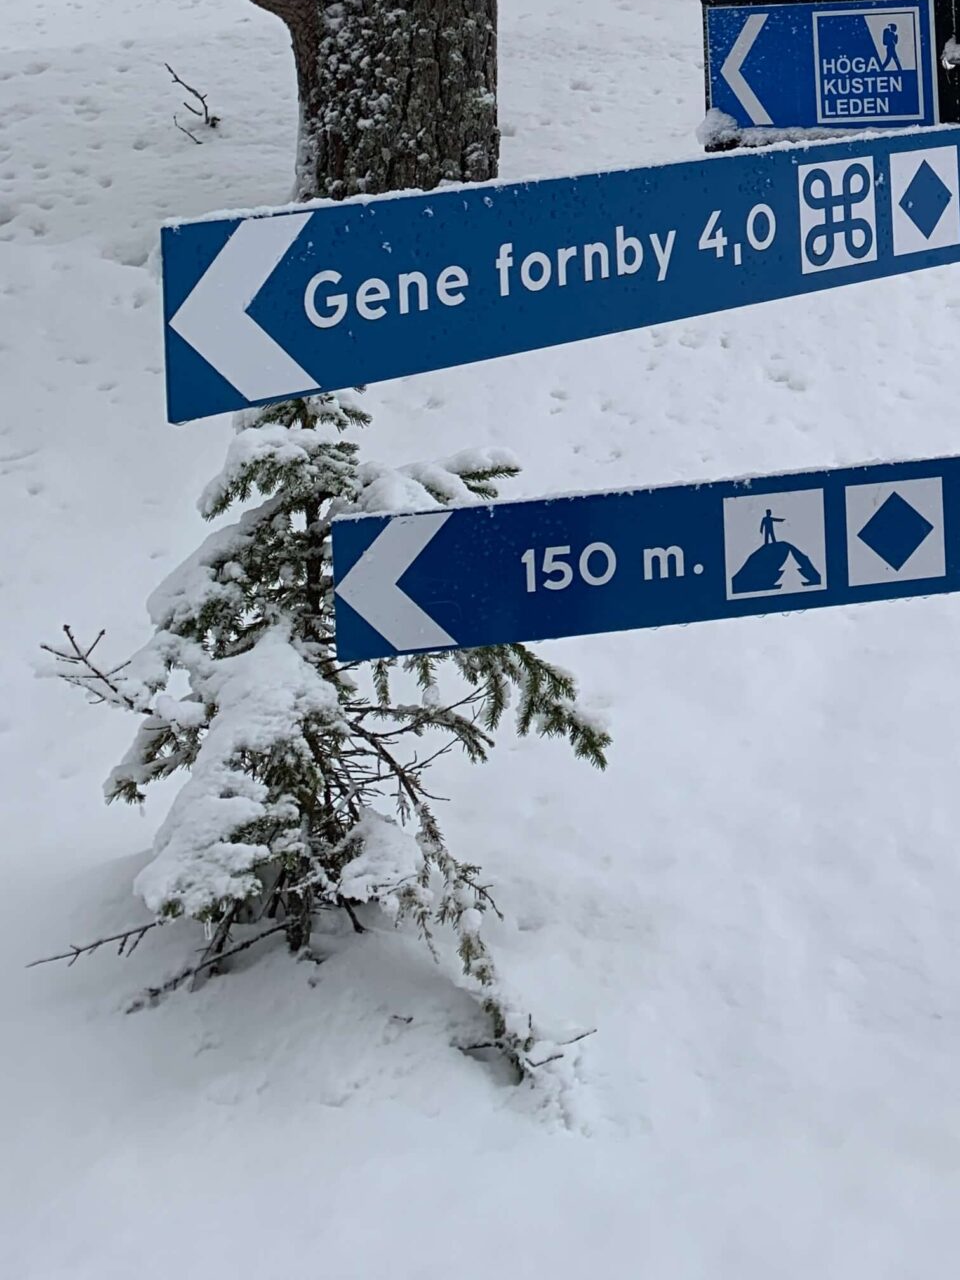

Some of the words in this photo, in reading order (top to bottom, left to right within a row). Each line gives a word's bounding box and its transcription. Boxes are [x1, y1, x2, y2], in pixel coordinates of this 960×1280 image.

[822, 55, 880, 74] HÖGA
[823, 76, 902, 95] KUSTEN
[824, 97, 889, 115] LEDEN
[304, 266, 469, 328] Gene
[496, 226, 676, 296] fornby
[699, 204, 776, 265] 4,0
[521, 542, 617, 592] 150
[643, 545, 704, 580] m.
